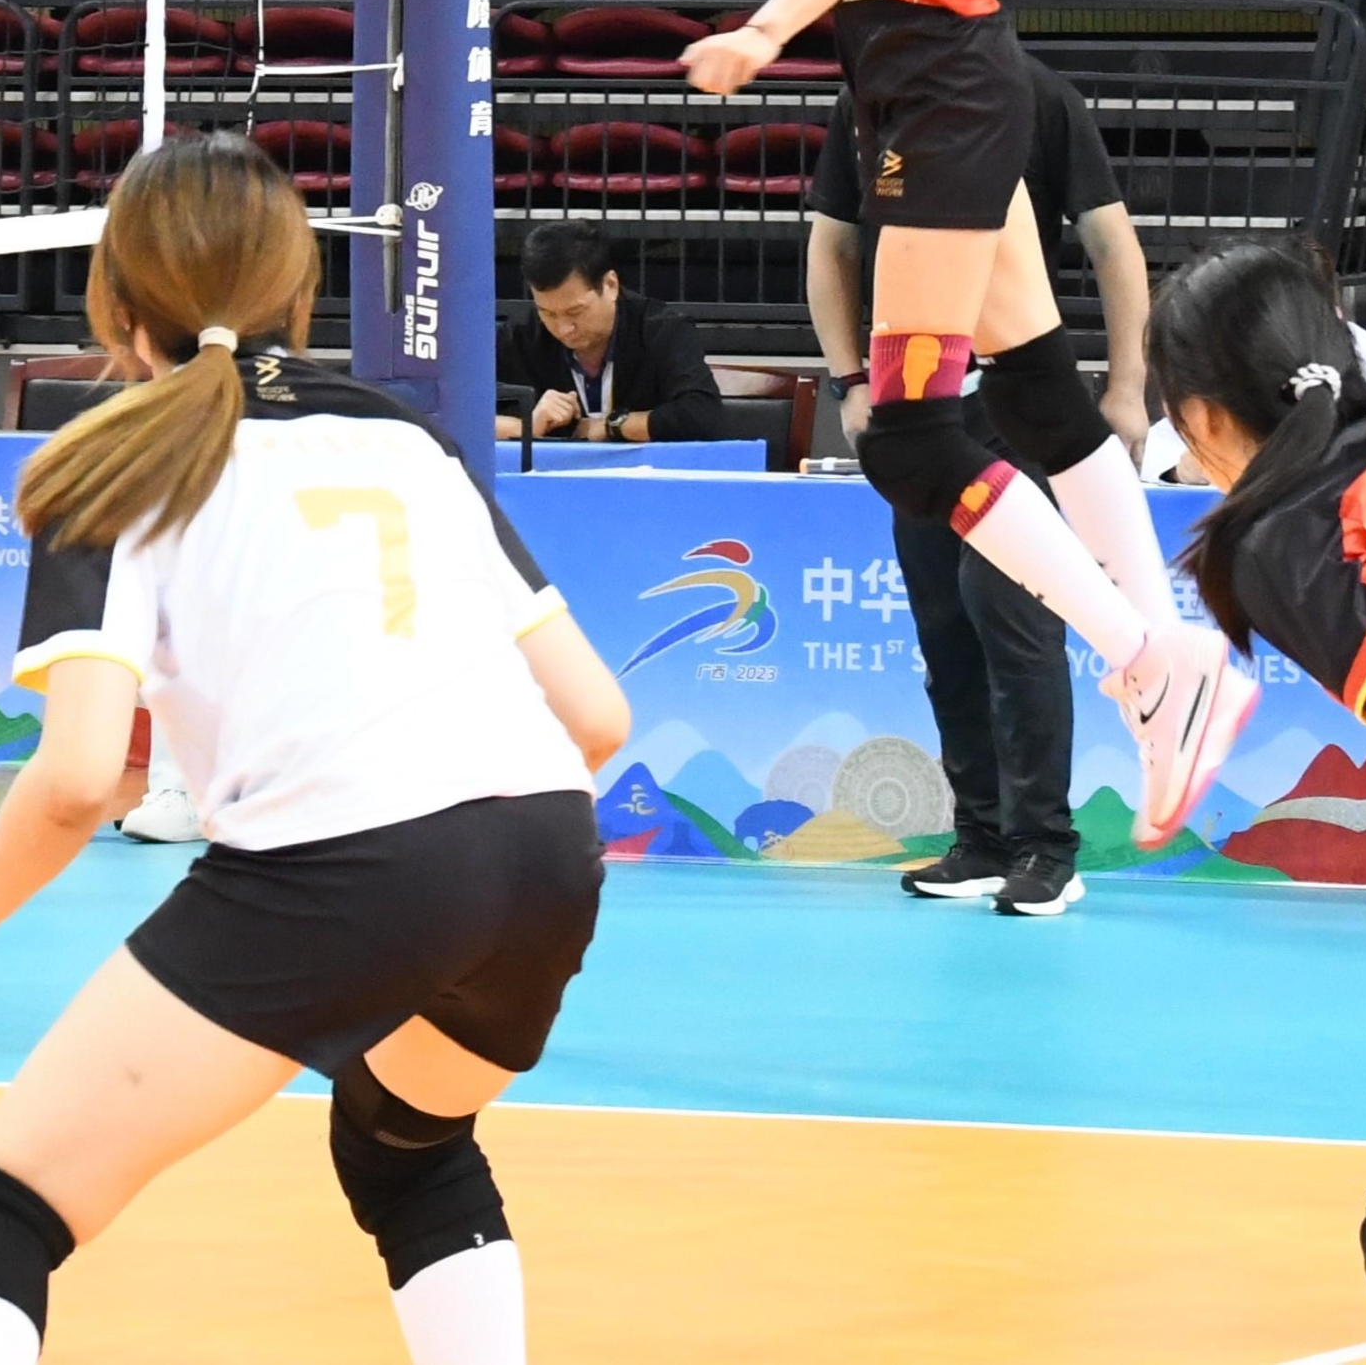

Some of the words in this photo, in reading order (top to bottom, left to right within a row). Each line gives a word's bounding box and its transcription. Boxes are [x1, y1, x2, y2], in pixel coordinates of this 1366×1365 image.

[403, 294, 415, 356] SPORTS
[415, 219, 439, 361] JINLING
[292, 487, 416, 638] 7
[802, 642, 863, 671] THE
